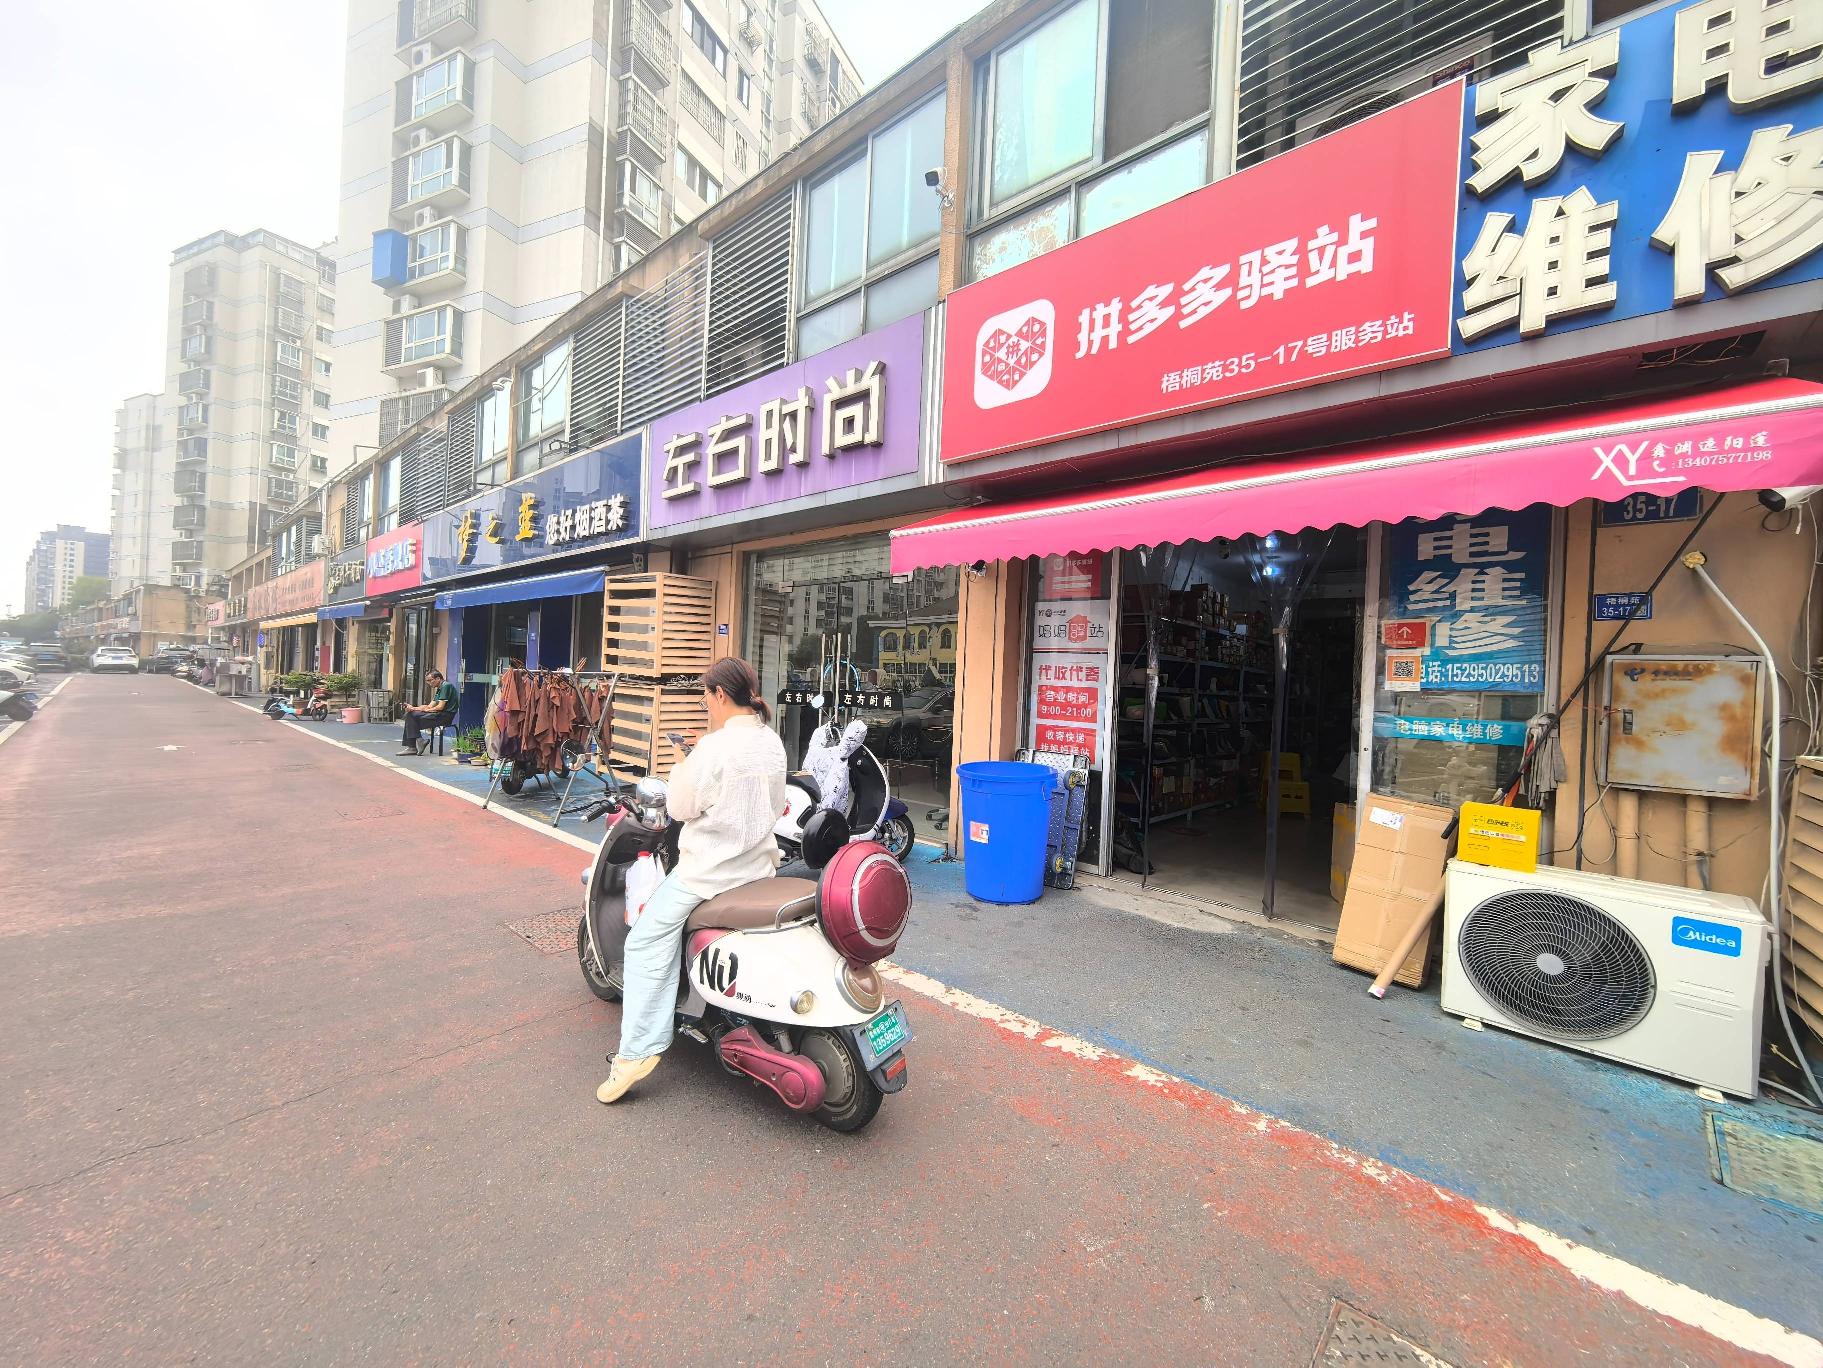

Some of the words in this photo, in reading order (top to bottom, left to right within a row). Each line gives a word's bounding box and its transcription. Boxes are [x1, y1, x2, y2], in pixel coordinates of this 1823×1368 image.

[1457, 124, 1823, 343] 维修
[1074, 212, 1378, 360] 拼多多驿站
[1160, 311, 1415, 394] 梧桐苑35-17号服务站
[662, 360, 886, 500] 左右时尚
[1623, 495, 1678, 519] 35-17
[1038, 664, 1100, 682] 代收代寄
[1045, 690, 1089, 704] 营业时间
[1041, 705, 1092, 718] 9:00-21:00
[1045, 729, 1085, 744] 收寄快递
[1677, 925, 1736, 948] Midea
